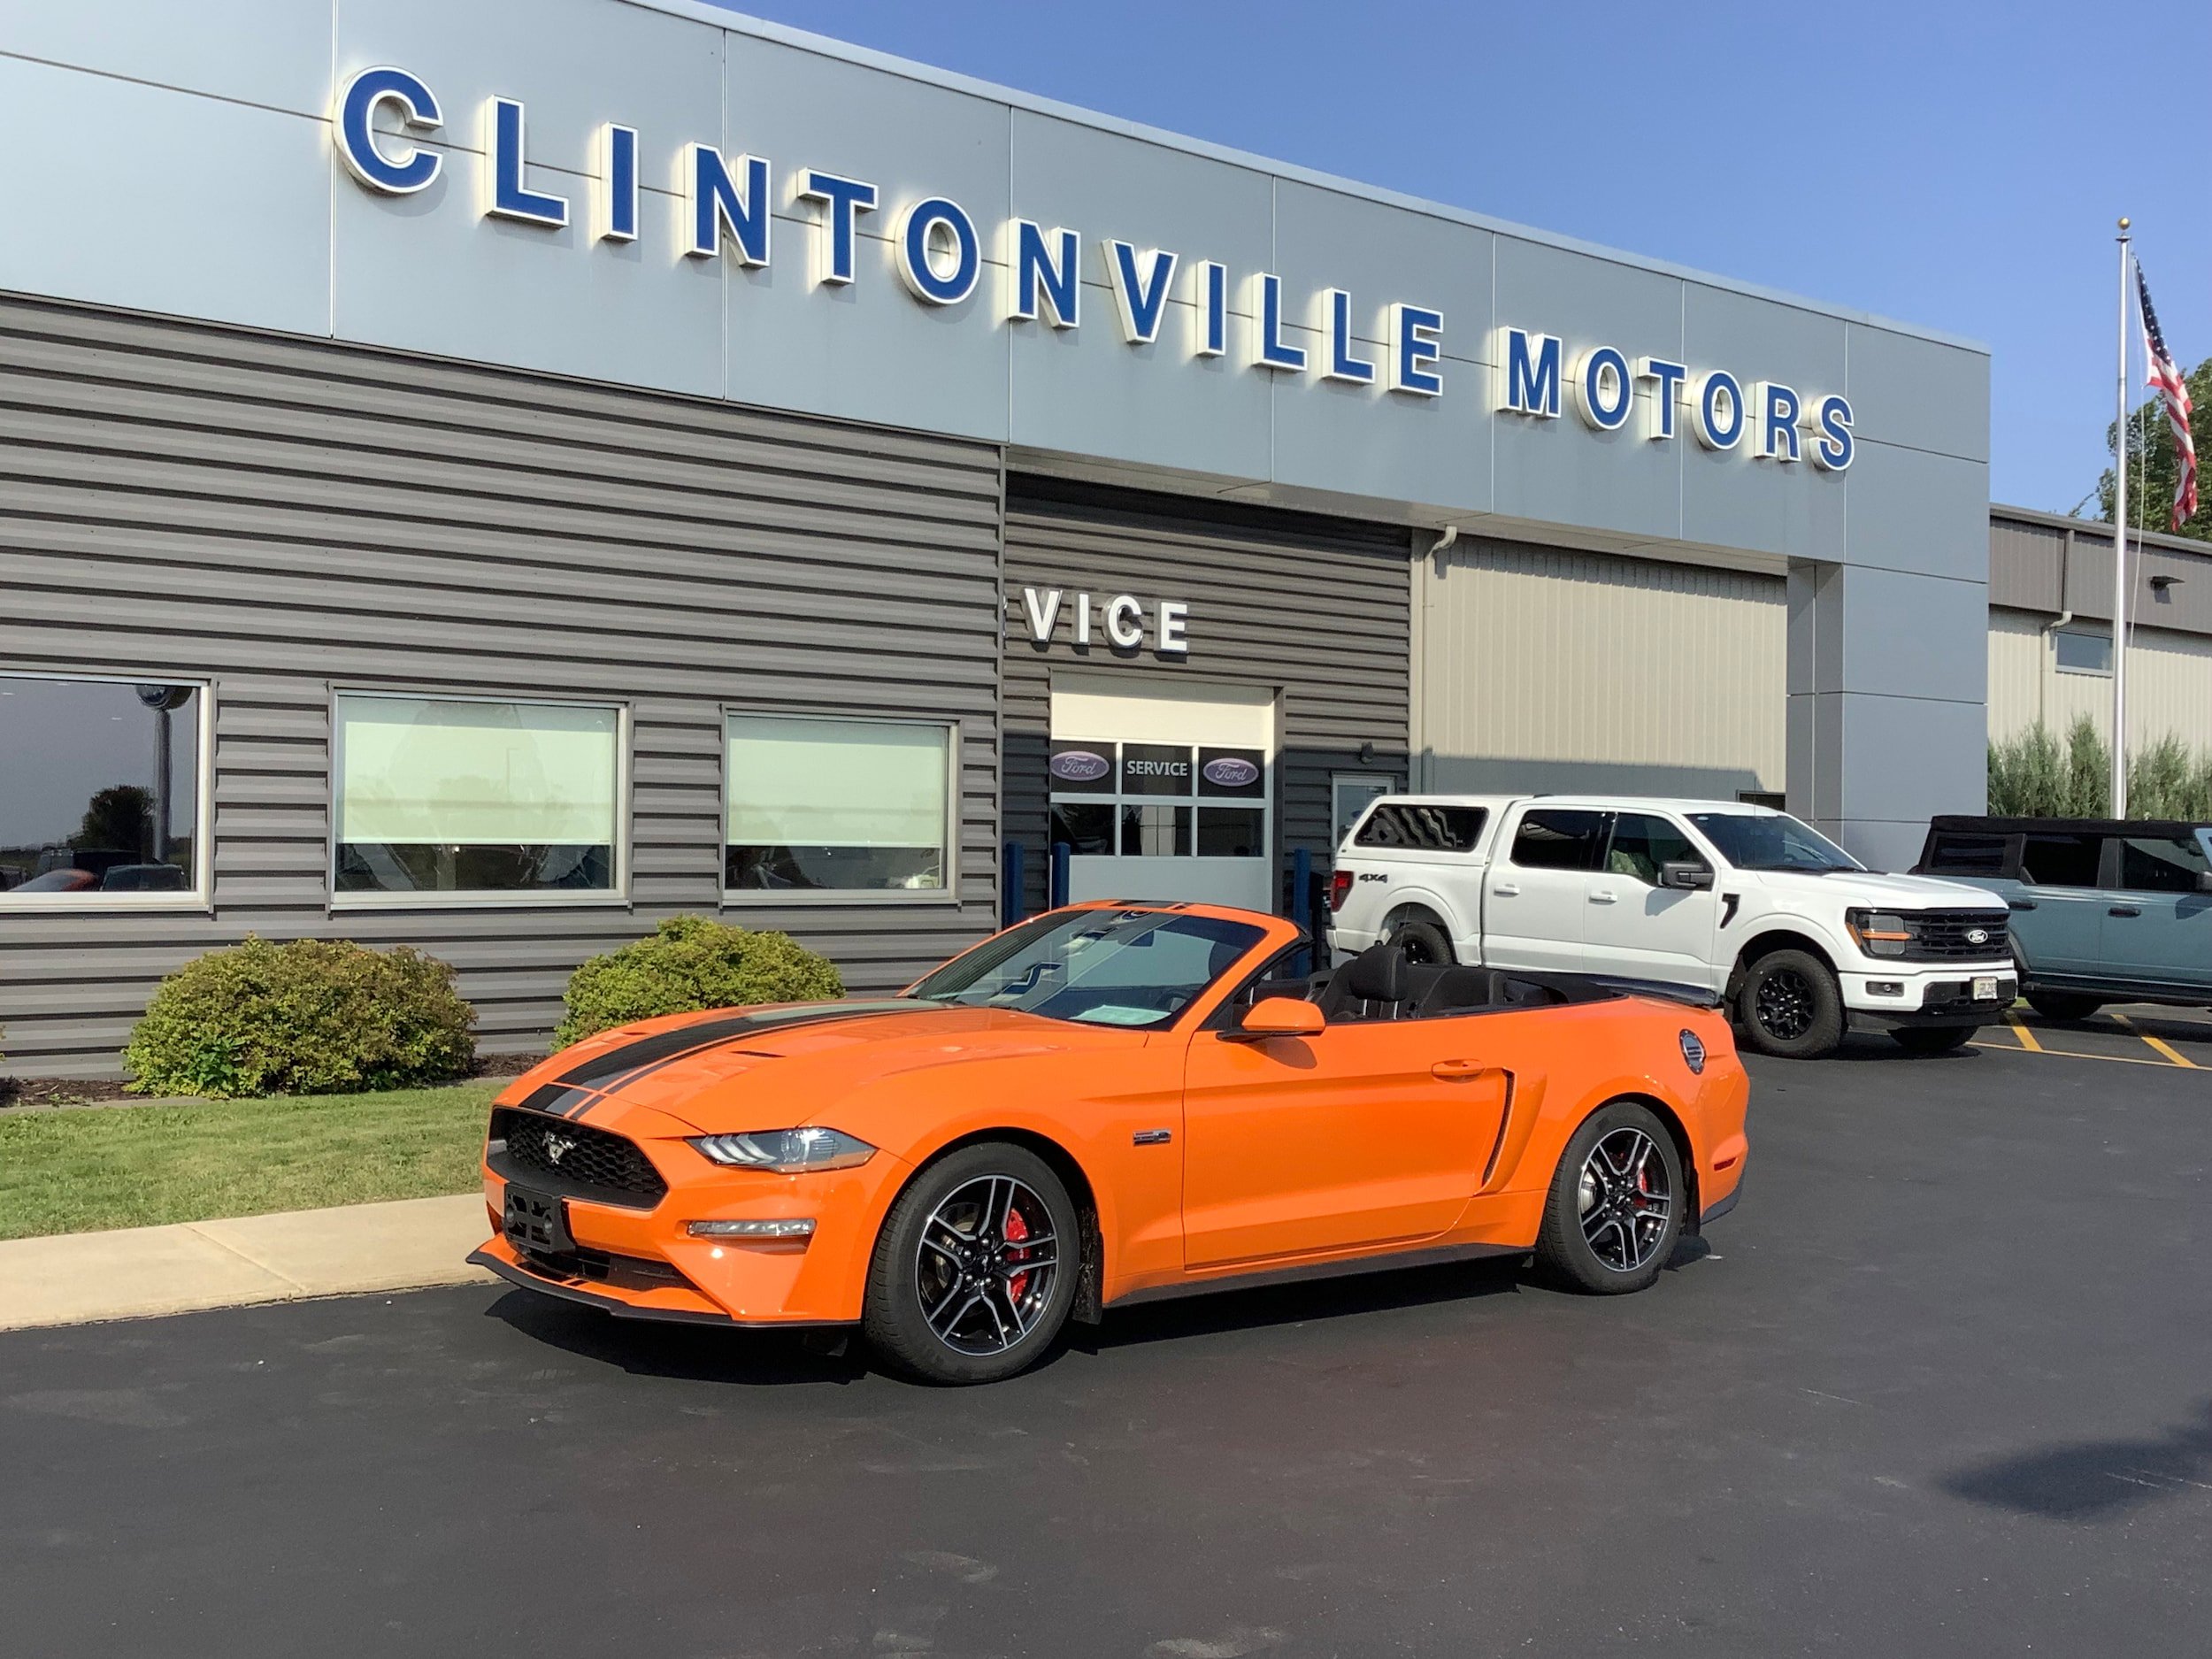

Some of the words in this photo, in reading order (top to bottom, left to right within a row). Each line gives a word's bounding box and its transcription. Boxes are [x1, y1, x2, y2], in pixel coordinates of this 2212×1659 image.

[334, 65, 1444, 398] CLINTONVILLE
[1499, 325, 1855, 472] MOTORS
[1002, 588, 1189, 653] VICE
[1062, 756, 1097, 775] Ford
[1126, 760, 1188, 776] SERVICE
[1215, 763, 1248, 781] Ford
